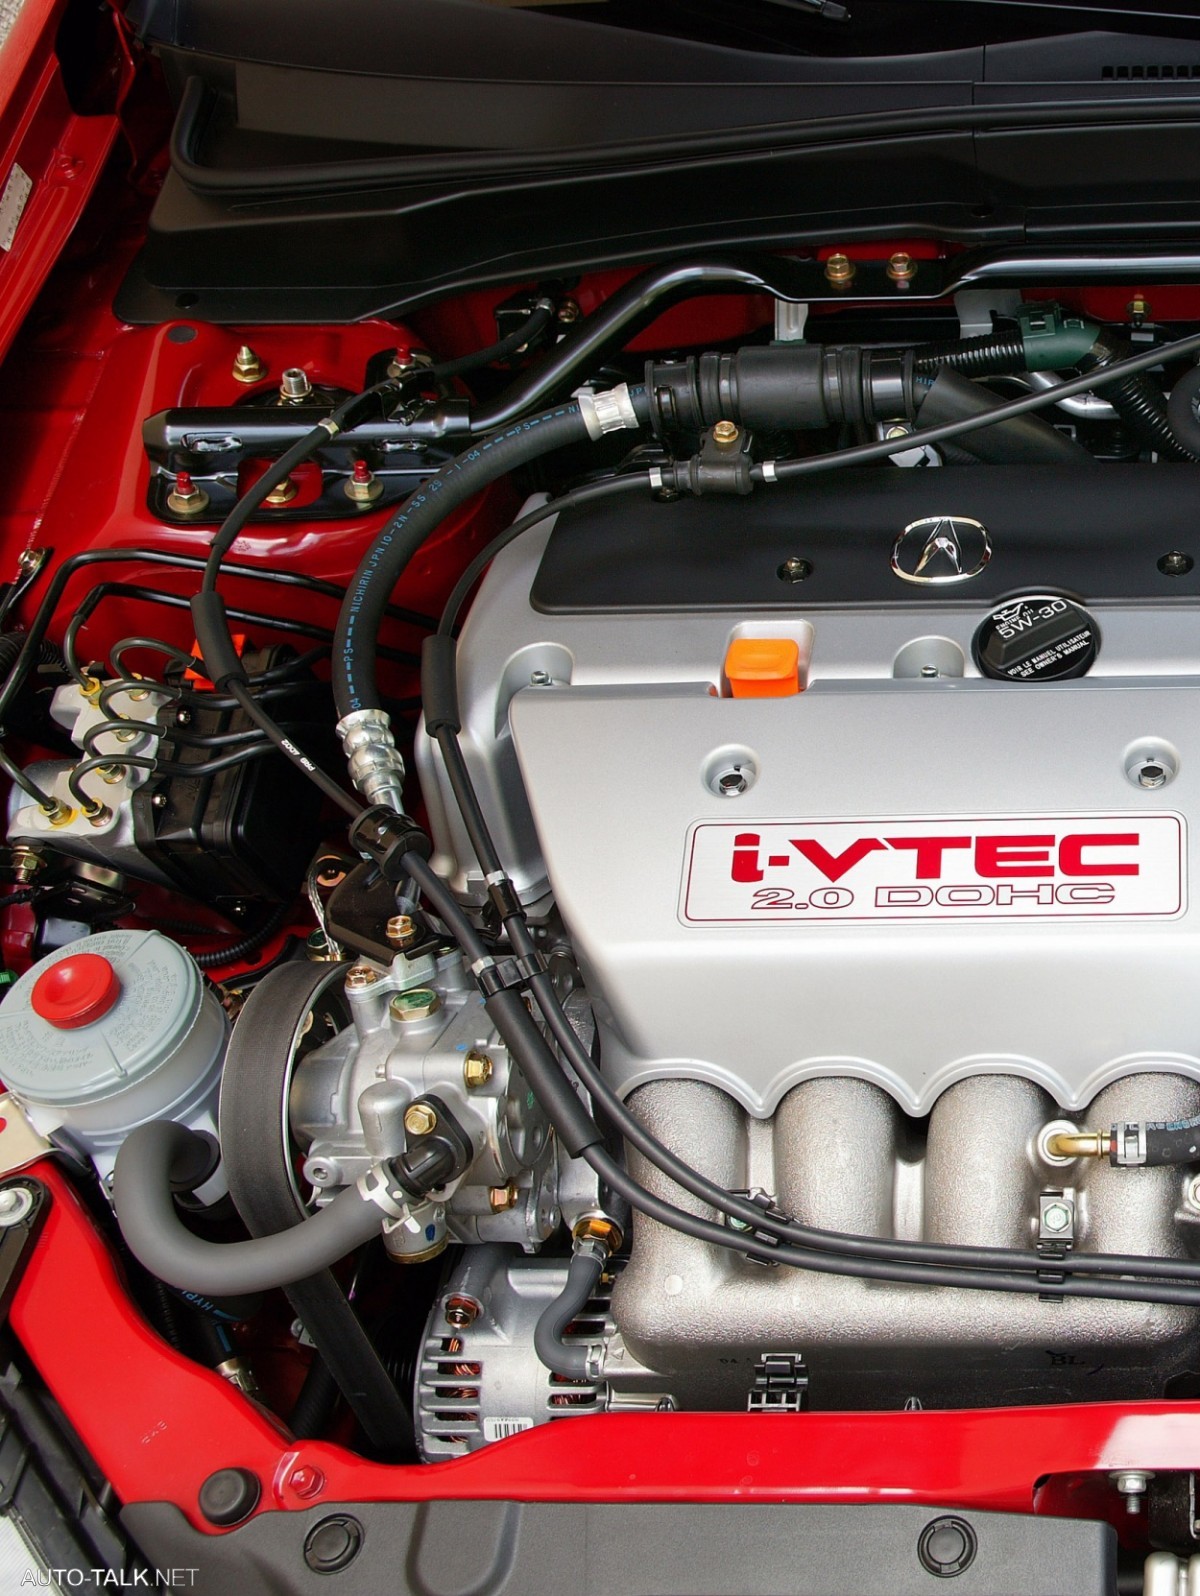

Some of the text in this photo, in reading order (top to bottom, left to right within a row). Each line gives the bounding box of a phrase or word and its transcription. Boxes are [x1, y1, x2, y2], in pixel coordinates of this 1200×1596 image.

[352, 568, 373, 614] NICHIRIN
[998, 599, 1068, 639] 5W-30
[1020, 667, 1035, 678] SEE
[1063, 640, 1090, 655] MANUAL
[731, 832, 1140, 883] i-VTEC
[751, 883, 1116, 910] 2.0 DOHC
